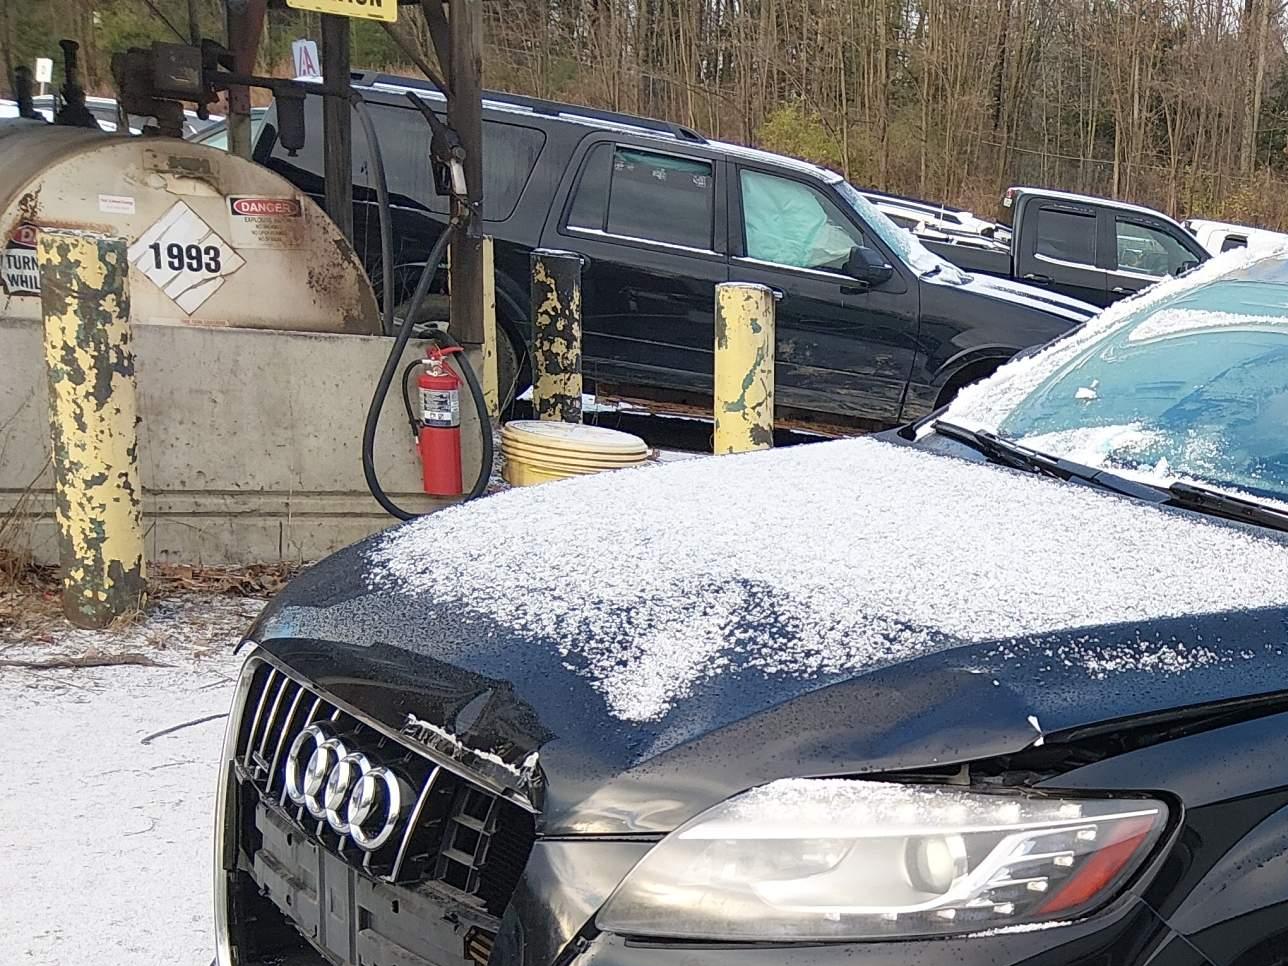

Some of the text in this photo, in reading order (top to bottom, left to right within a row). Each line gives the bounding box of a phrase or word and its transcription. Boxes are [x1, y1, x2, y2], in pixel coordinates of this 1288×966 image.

[241, 201, 291, 213] DANGER
[148, 242, 221, 273] 1993
[7, 273, 41, 289] WHIL
